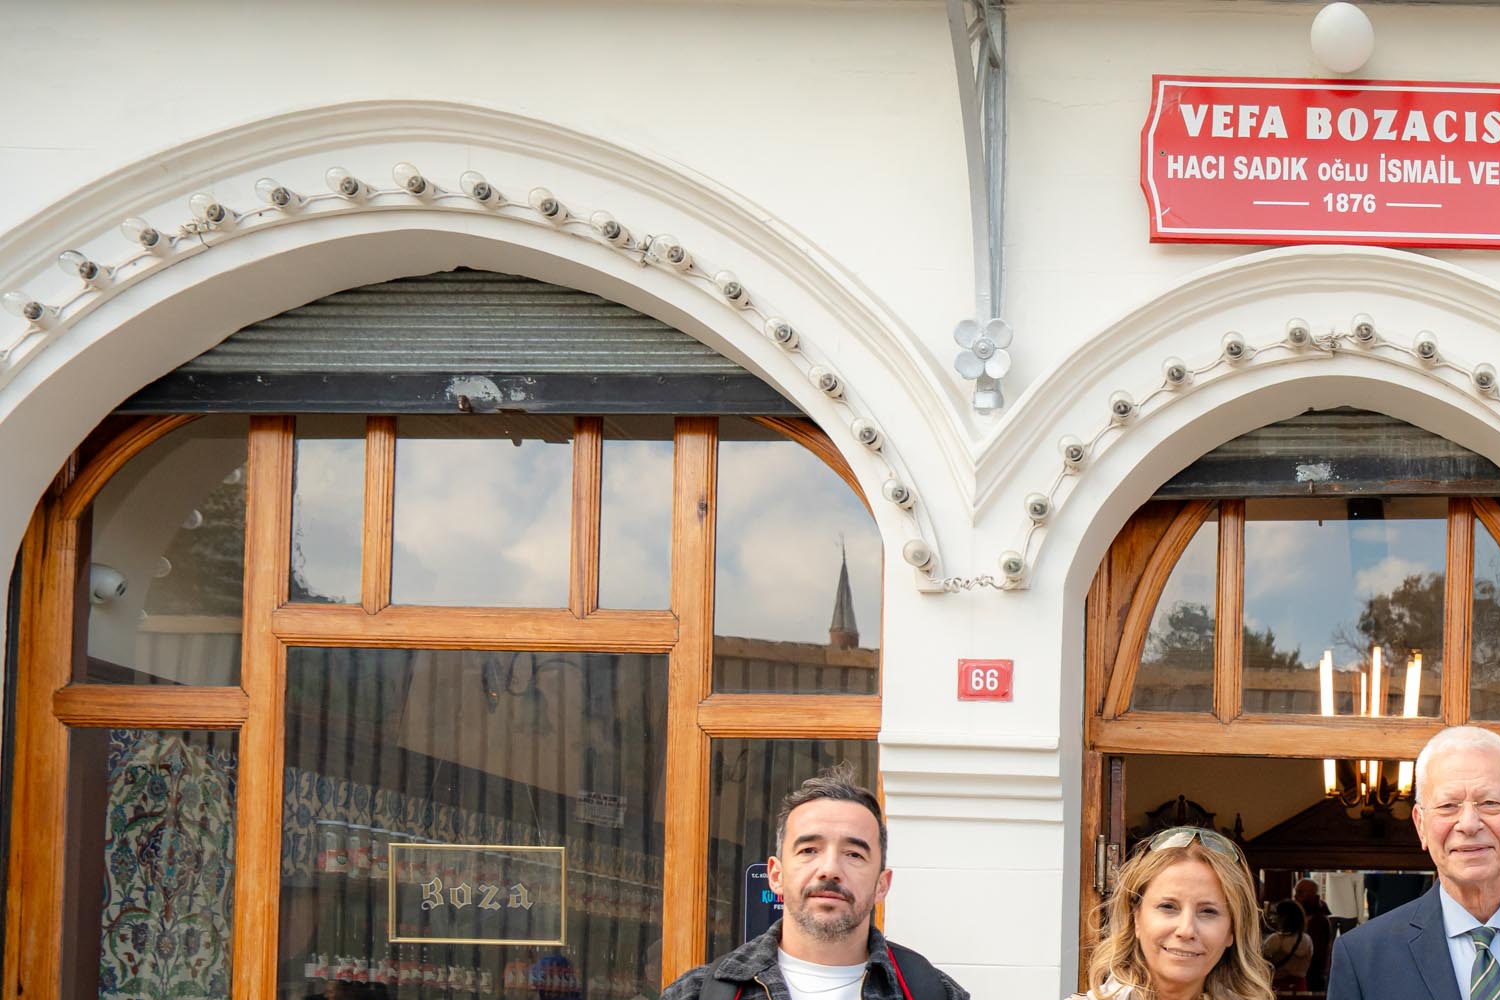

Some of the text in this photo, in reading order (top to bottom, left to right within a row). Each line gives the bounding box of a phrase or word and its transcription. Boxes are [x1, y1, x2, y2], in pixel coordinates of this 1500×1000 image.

[1179, 104, 1288, 139] VEFA
[1167, 154, 1225, 180] HACI
[1233, 155, 1308, 182] SADIK
[1317, 157, 1368, 182] OĞLU
[1379, 153, 1461, 185] İSMAİL
[1323, 193, 1377, 213] 1876
[971, 668, 999, 691] 66
[420, 877, 534, 912] Boza
